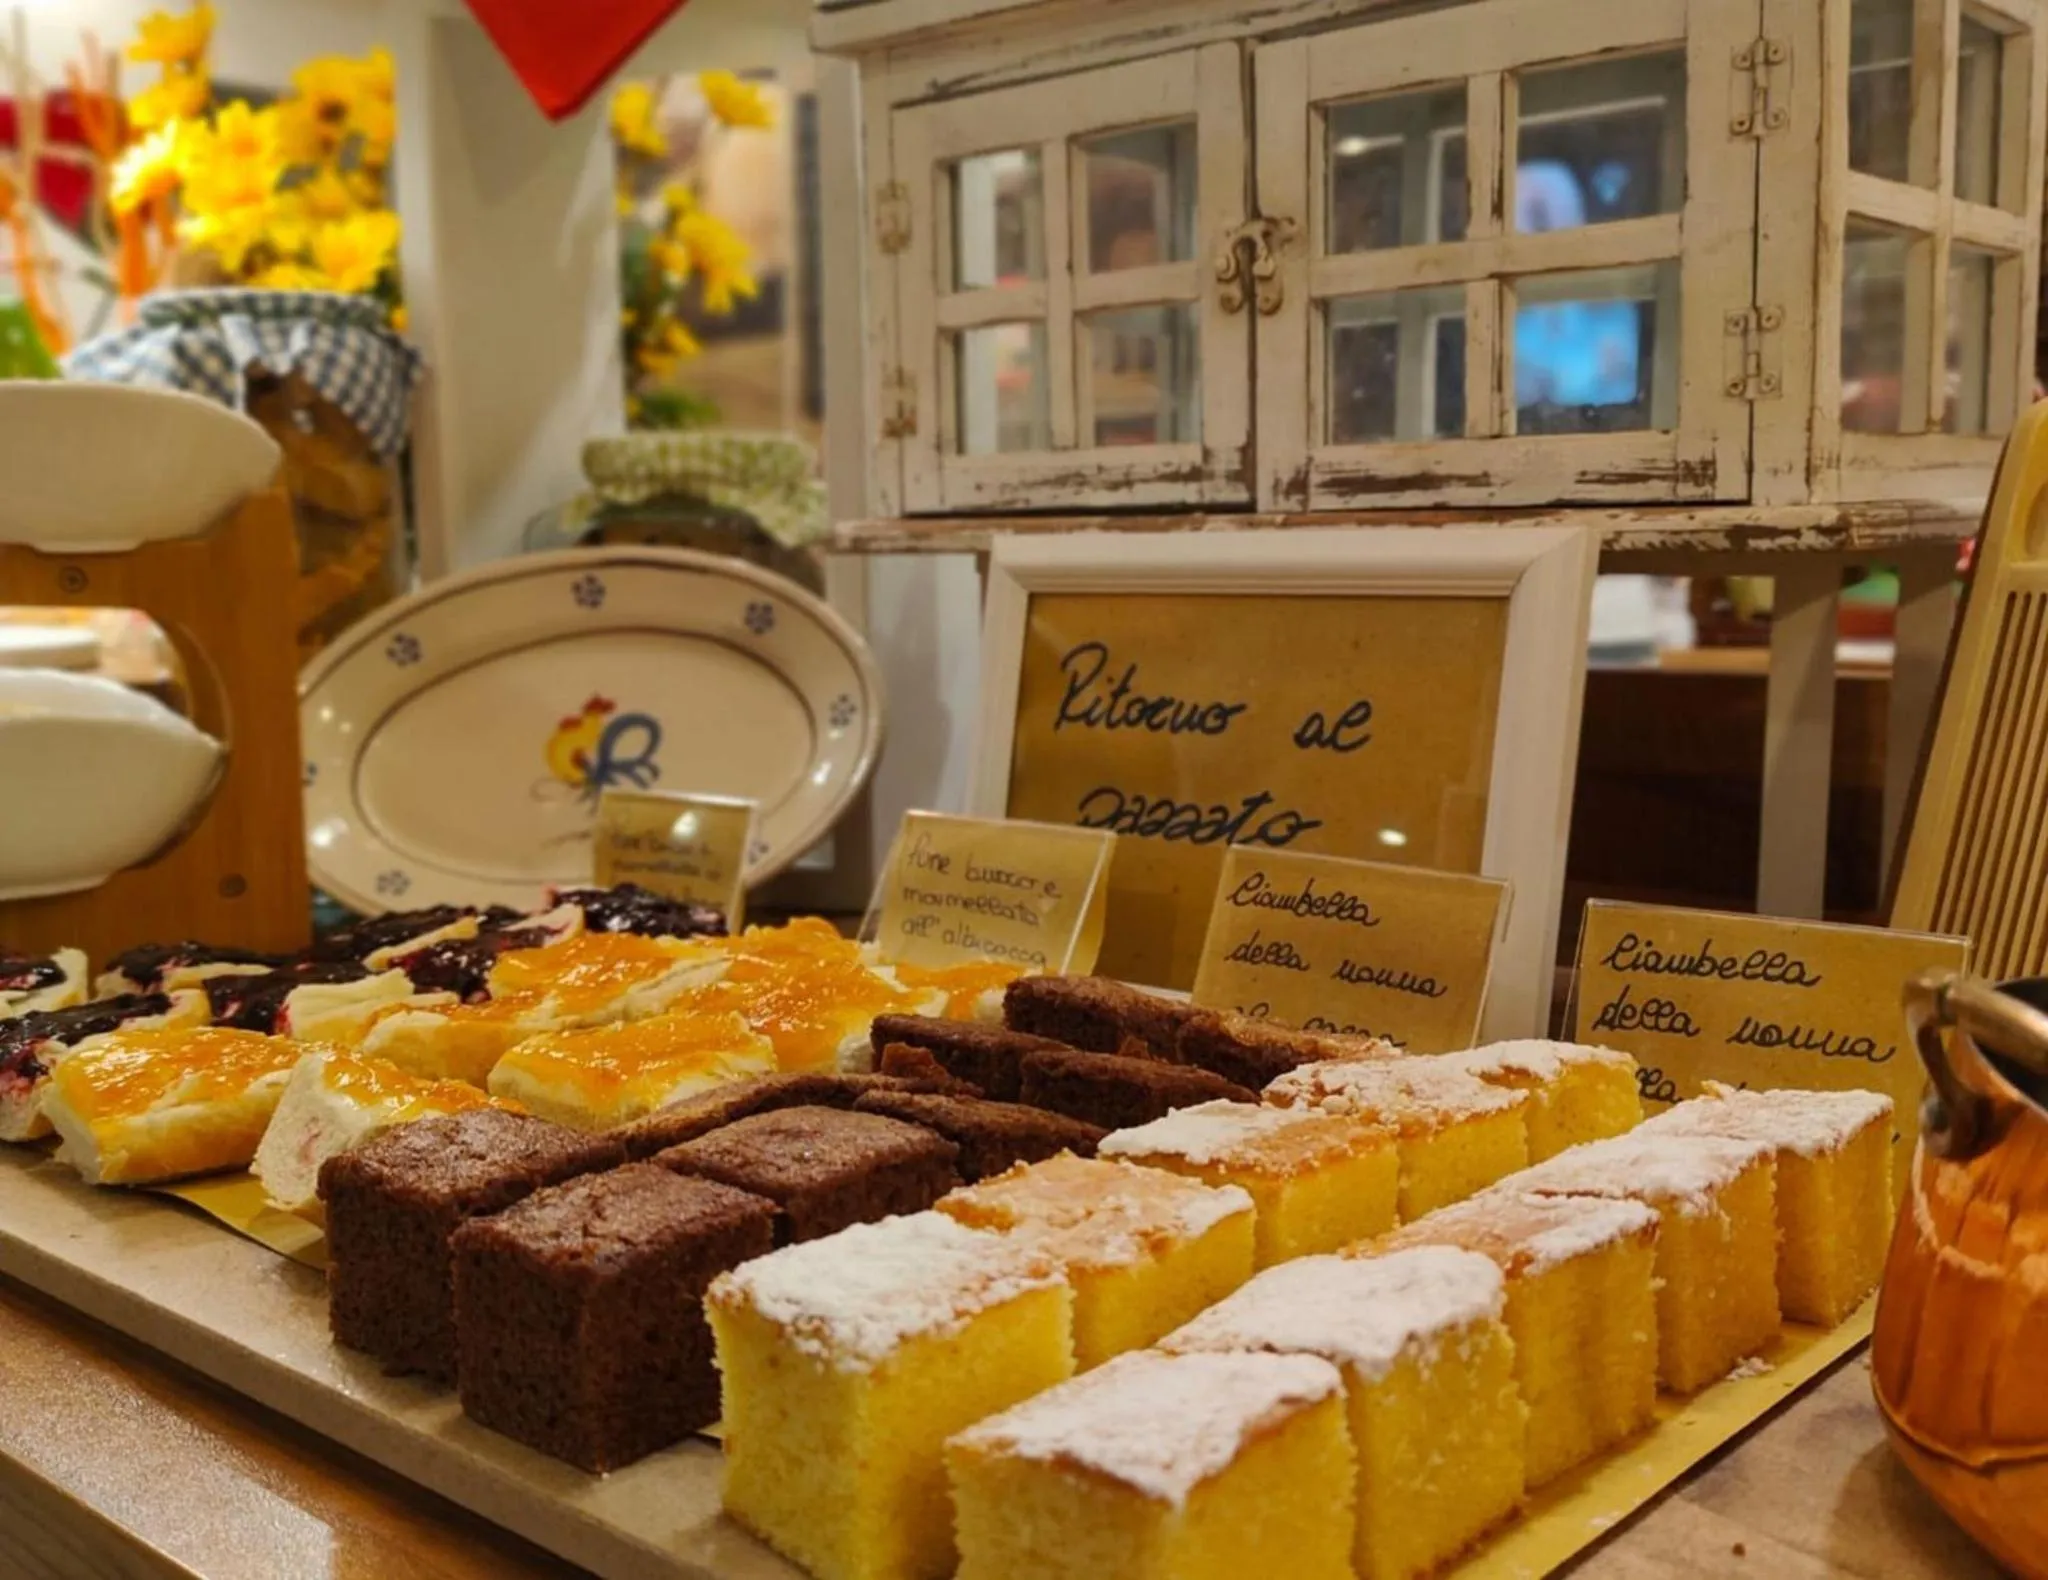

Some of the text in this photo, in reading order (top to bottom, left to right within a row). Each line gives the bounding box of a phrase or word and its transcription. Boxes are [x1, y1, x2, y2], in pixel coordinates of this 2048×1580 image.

[1053, 641, 1372, 752] Ritorno al
[1226, 872, 1381, 926] Ciambella
[1224, 930, 1448, 998] della nonna
[1601, 933, 1822, 988] Ciambella
[1591, 984, 1897, 1063] della nonna
